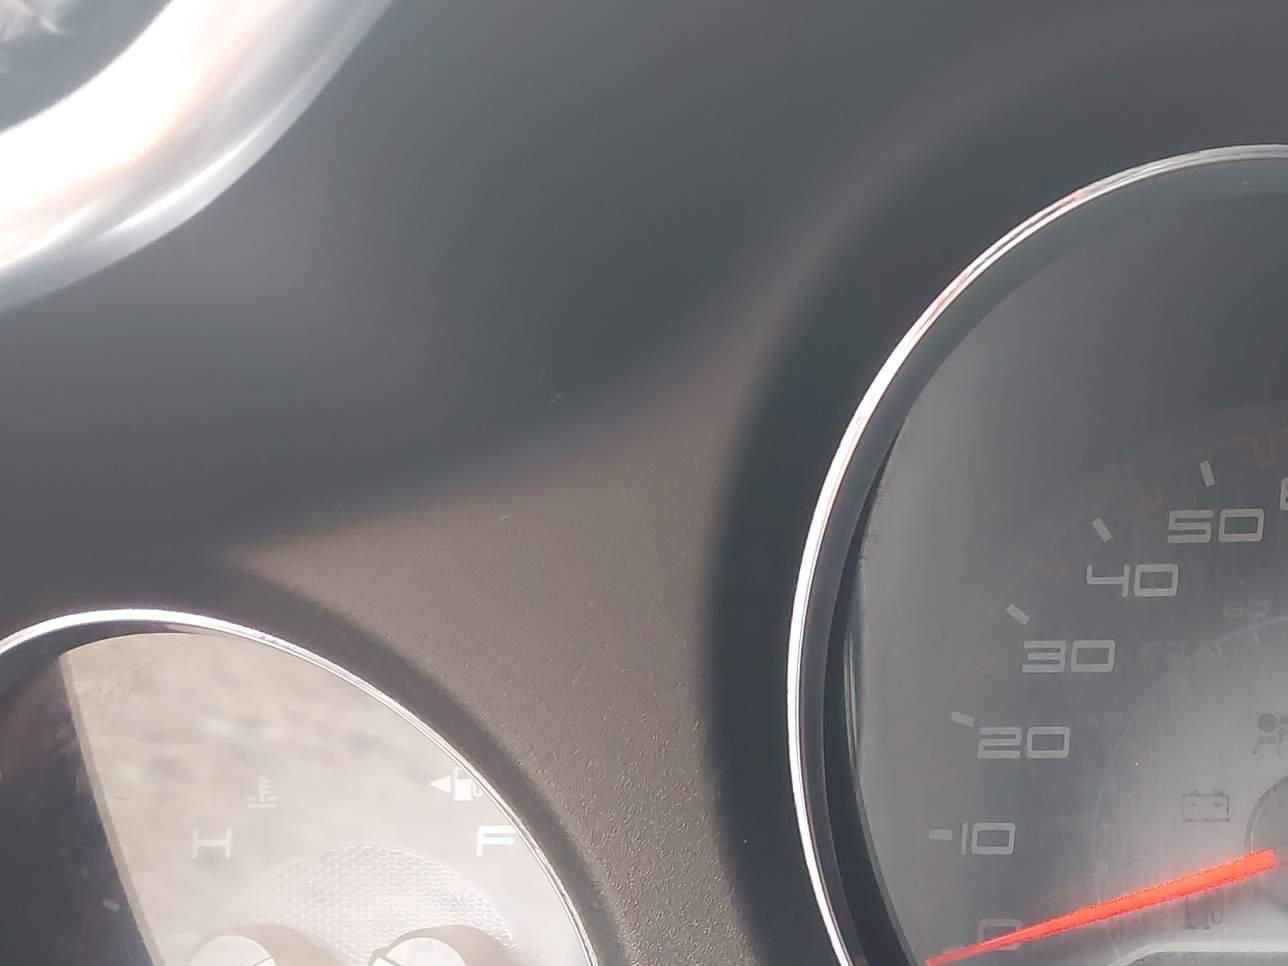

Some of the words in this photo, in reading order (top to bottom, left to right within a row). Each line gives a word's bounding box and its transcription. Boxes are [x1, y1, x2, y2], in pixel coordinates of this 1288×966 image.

[1167, 508, 1265, 544] 50
[1086, 562, 1179, 598] 40
[1022, 639, 1116, 674] 30
[977, 726, 1071, 760] 20
[191, 827, 233, 860] H
[476, 824, 516, 857] F
[960, 822, 1017, 856] 10
